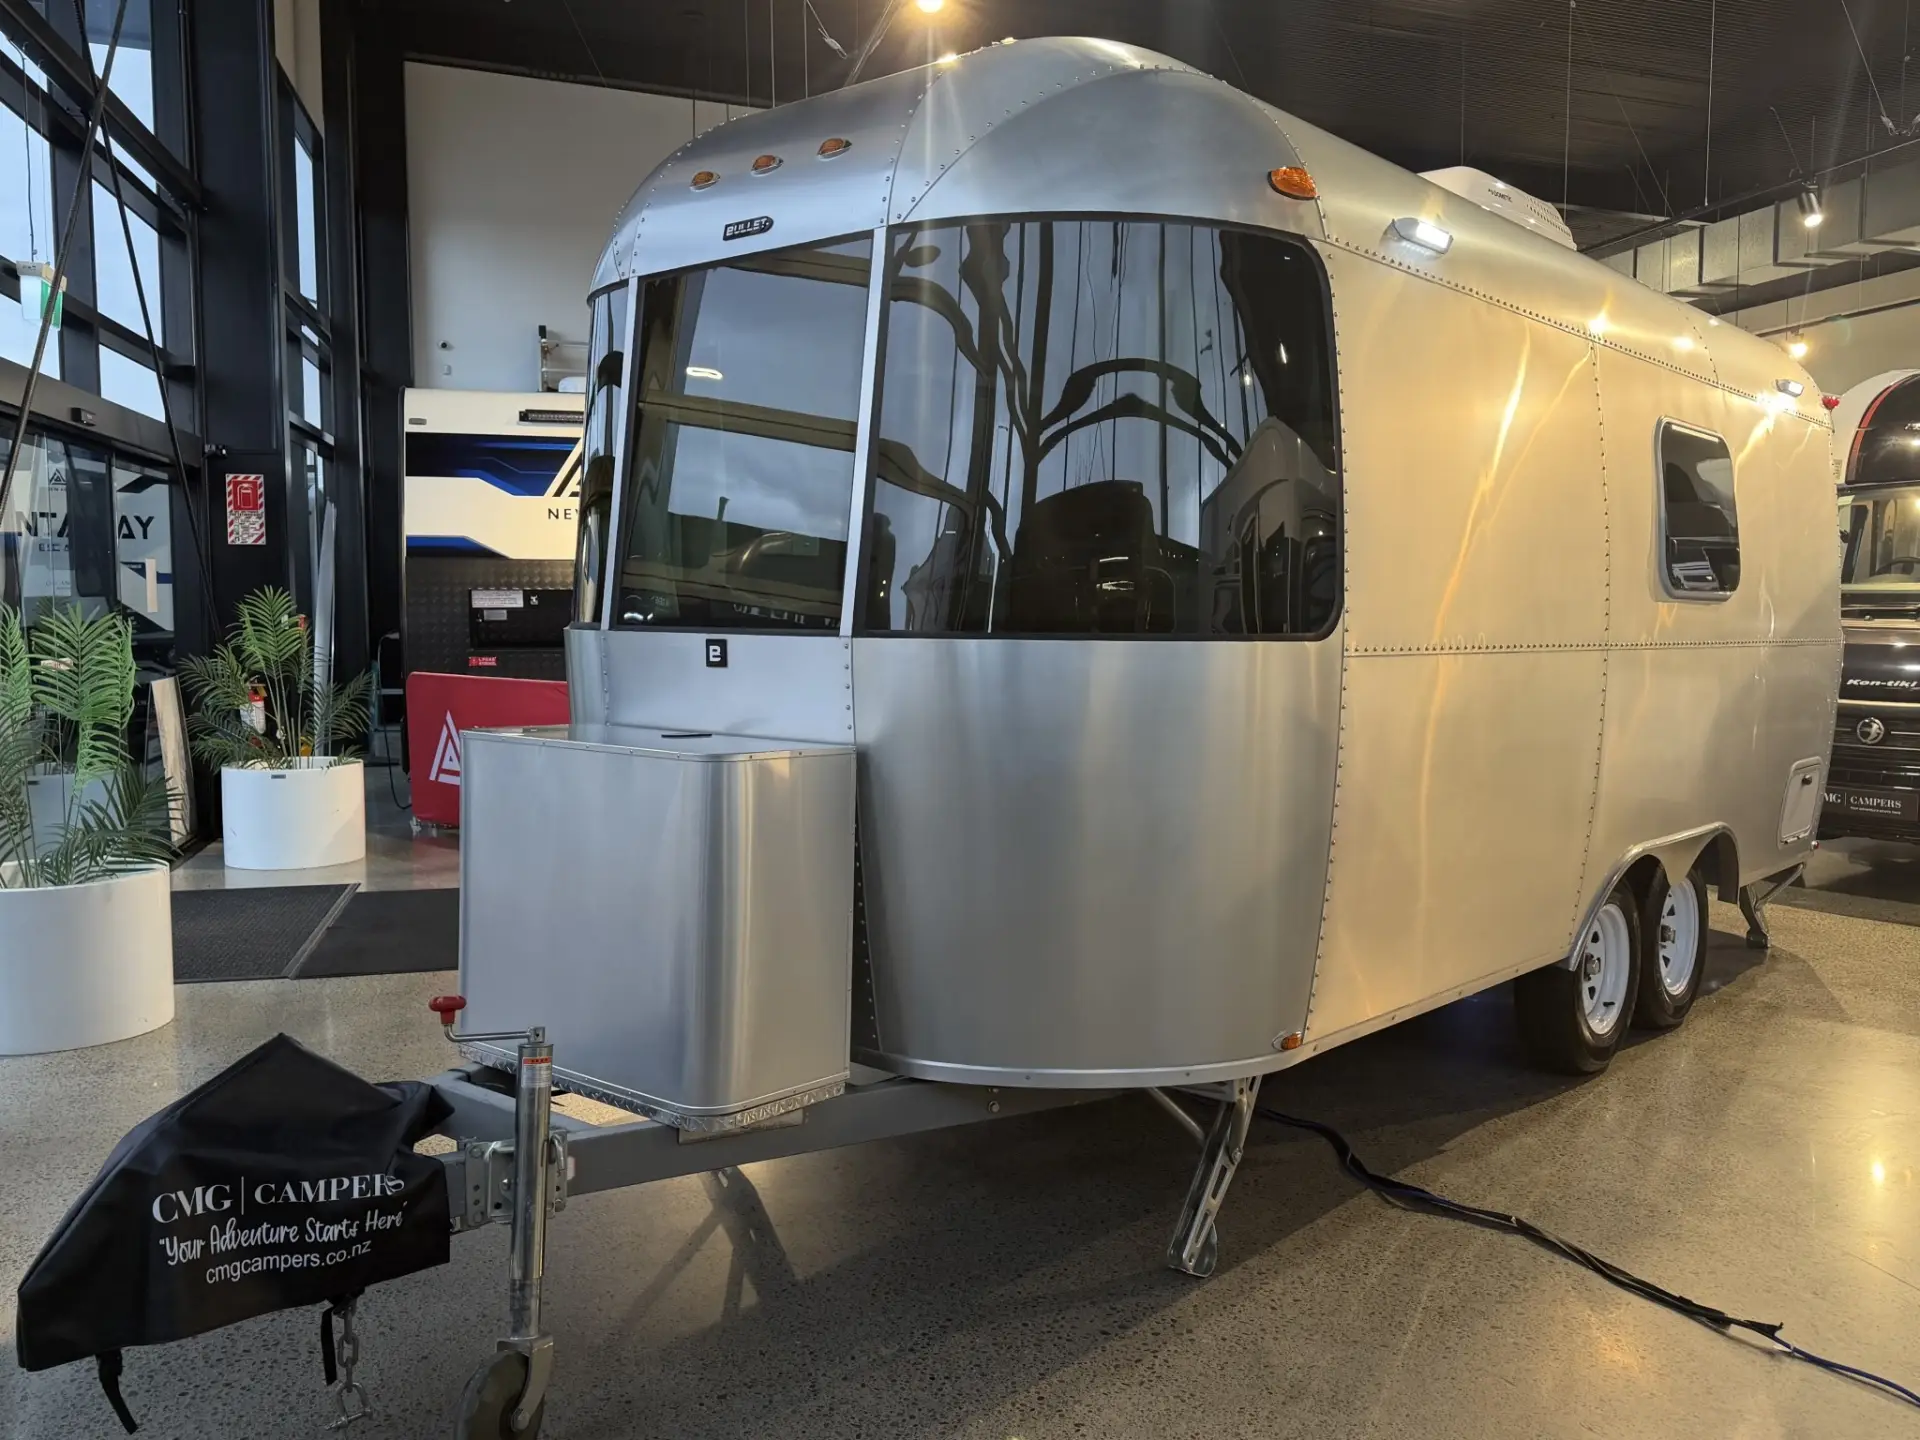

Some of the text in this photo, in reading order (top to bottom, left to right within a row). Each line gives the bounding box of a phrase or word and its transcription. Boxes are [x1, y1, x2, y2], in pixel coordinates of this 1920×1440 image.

[726, 217, 768, 237] BULLET
[547, 507, 579, 520] NE
[1846, 678, 1918, 688] Kon-tiki
[1849, 795, 1902, 809] CAMPERS
[152, 1173, 405, 1224] CMG CAMPERS
[210, 1217, 300, 1255] Adventure
[304, 1217, 360, 1244] Starts
[206, 1240, 371, 1284] cmgcampers.co.nz
